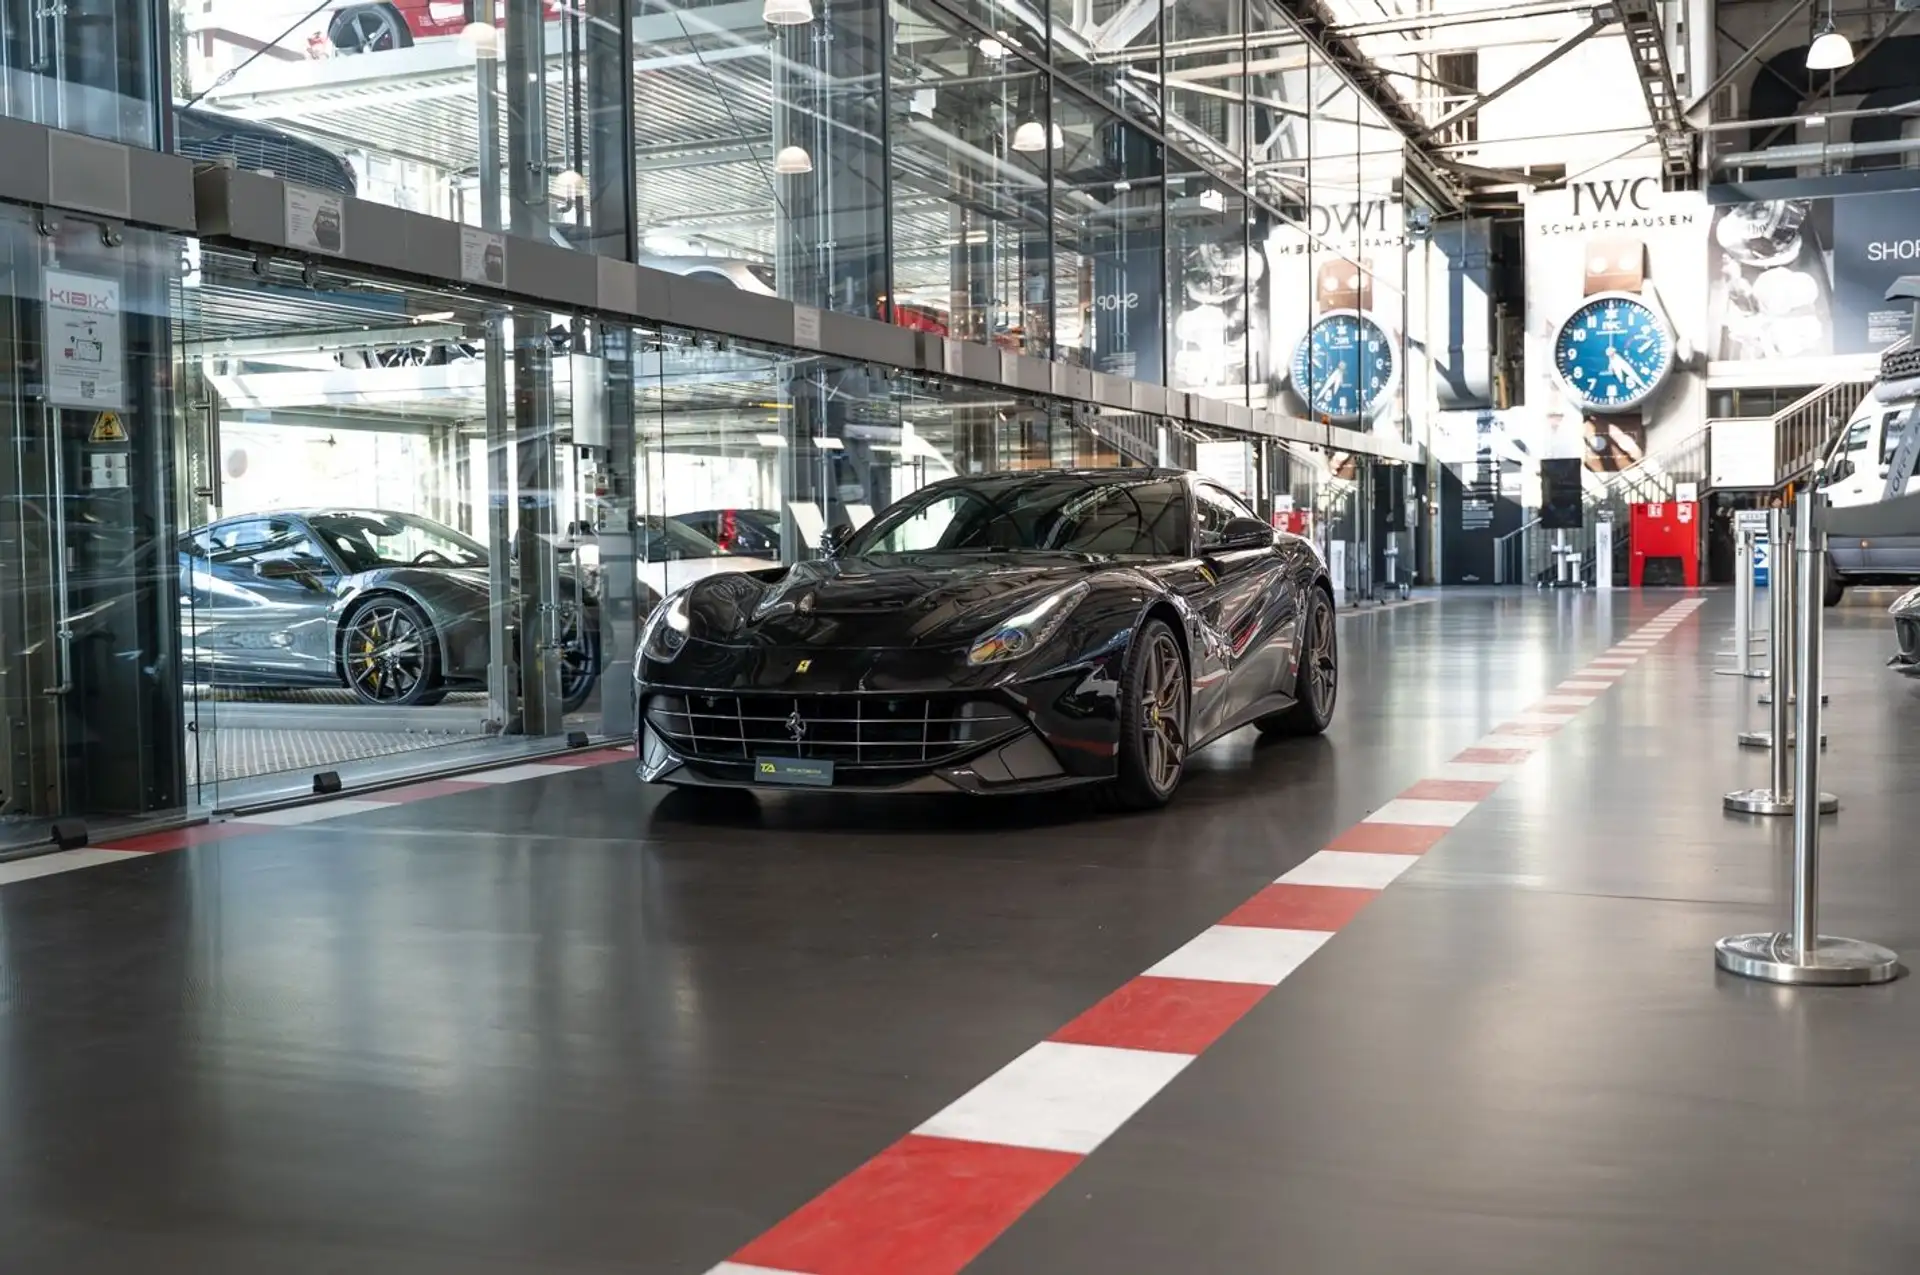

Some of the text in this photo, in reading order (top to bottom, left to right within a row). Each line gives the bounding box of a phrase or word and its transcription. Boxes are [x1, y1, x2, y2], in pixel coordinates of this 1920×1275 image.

[1572, 176, 1659, 216] IWC
[1540, 214, 1694, 236] SCHAFFHAUSEN
[1573, 329, 1586, 341] 10
[1568, 348, 1577, 360] 9
[1574, 367, 1583, 378] 8
[1587, 378, 1597, 390] 7
